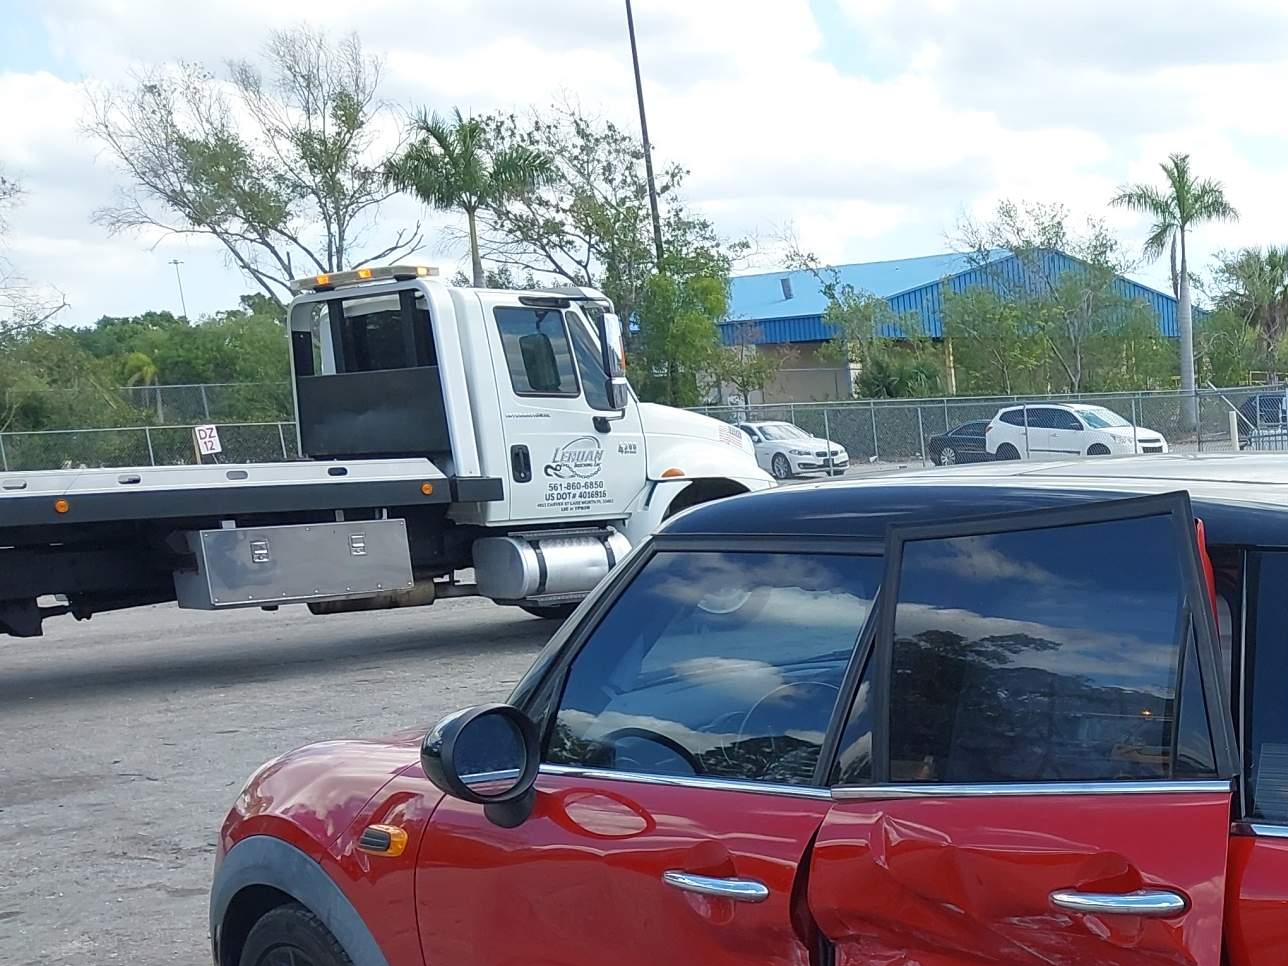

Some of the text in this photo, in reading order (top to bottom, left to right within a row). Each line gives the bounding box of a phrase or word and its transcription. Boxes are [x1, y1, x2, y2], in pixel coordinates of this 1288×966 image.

[198, 427, 216, 440] DZ
[204, 440, 215, 451] 12
[548, 481, 604, 491] 561-860-6850
[545, 493, 555, 501] US
[556, 492, 577, 500] DOT#
